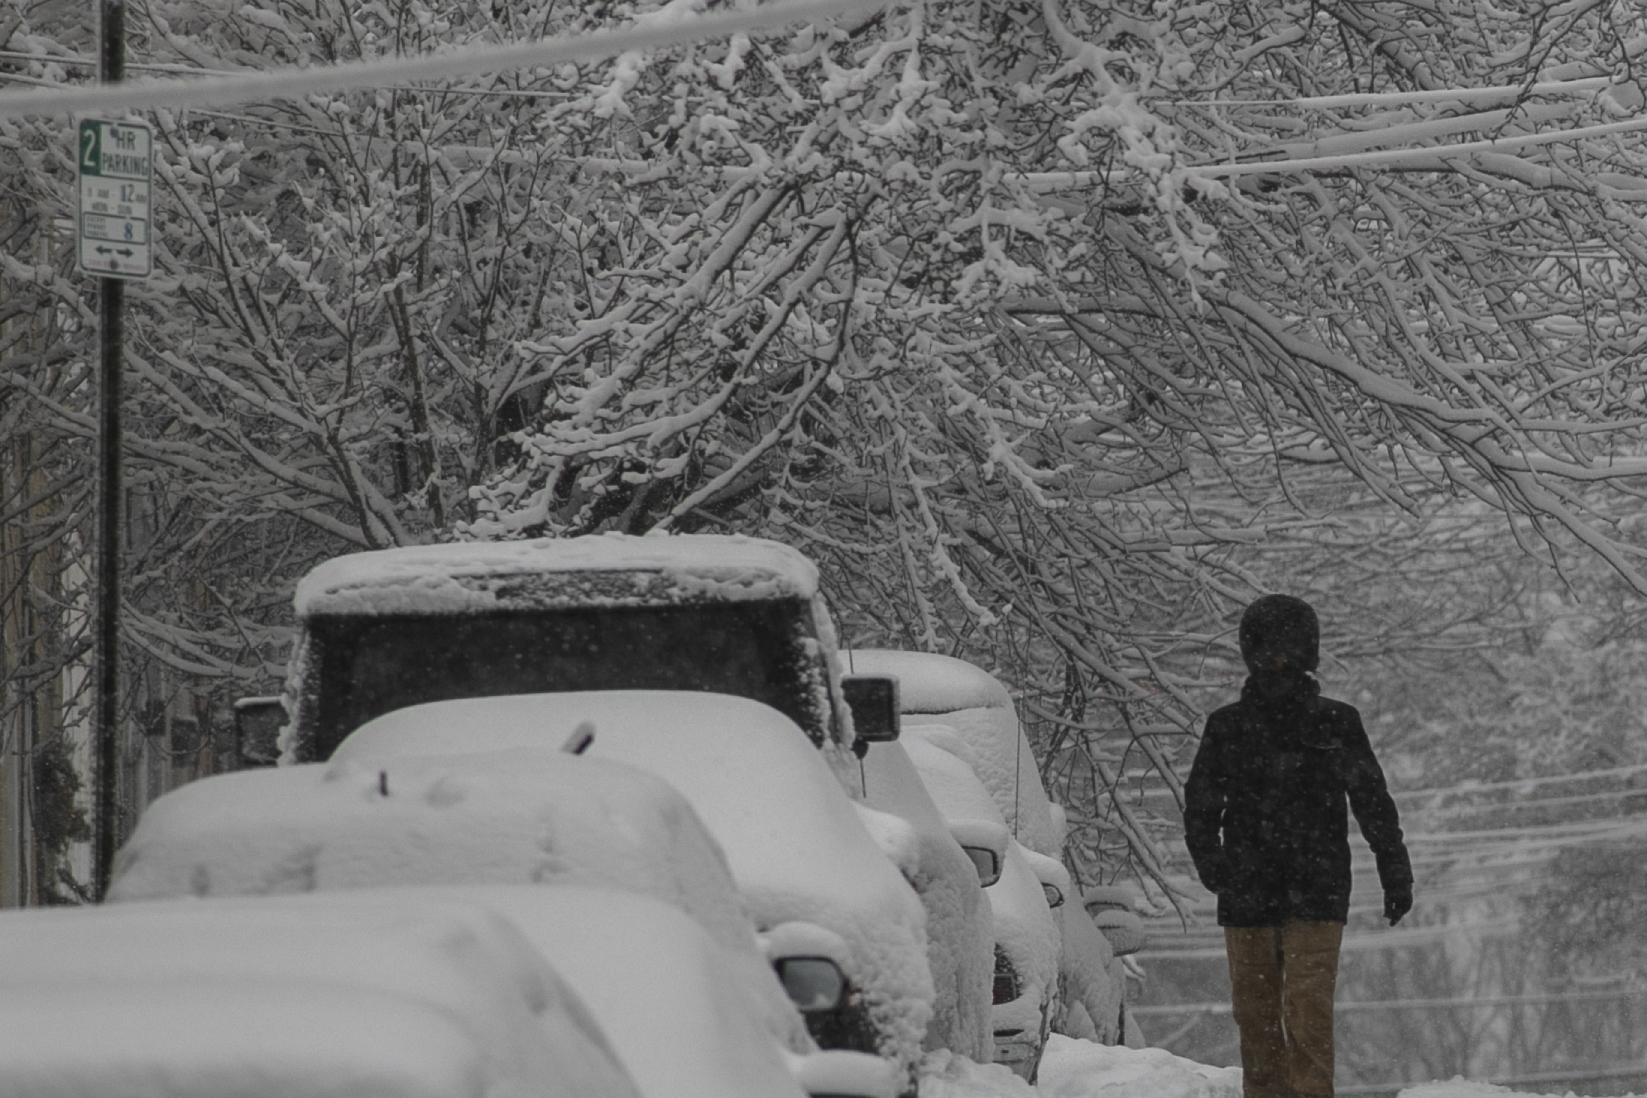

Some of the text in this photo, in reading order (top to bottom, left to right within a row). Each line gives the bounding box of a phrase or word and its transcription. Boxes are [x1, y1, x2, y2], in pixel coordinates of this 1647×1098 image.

[83, 129, 96, 167] 2
[116, 131, 136, 150] HR
[102, 153, 149, 176] PARKING
[120, 184, 135, 202] 12
[124, 221, 133, 241] 8
